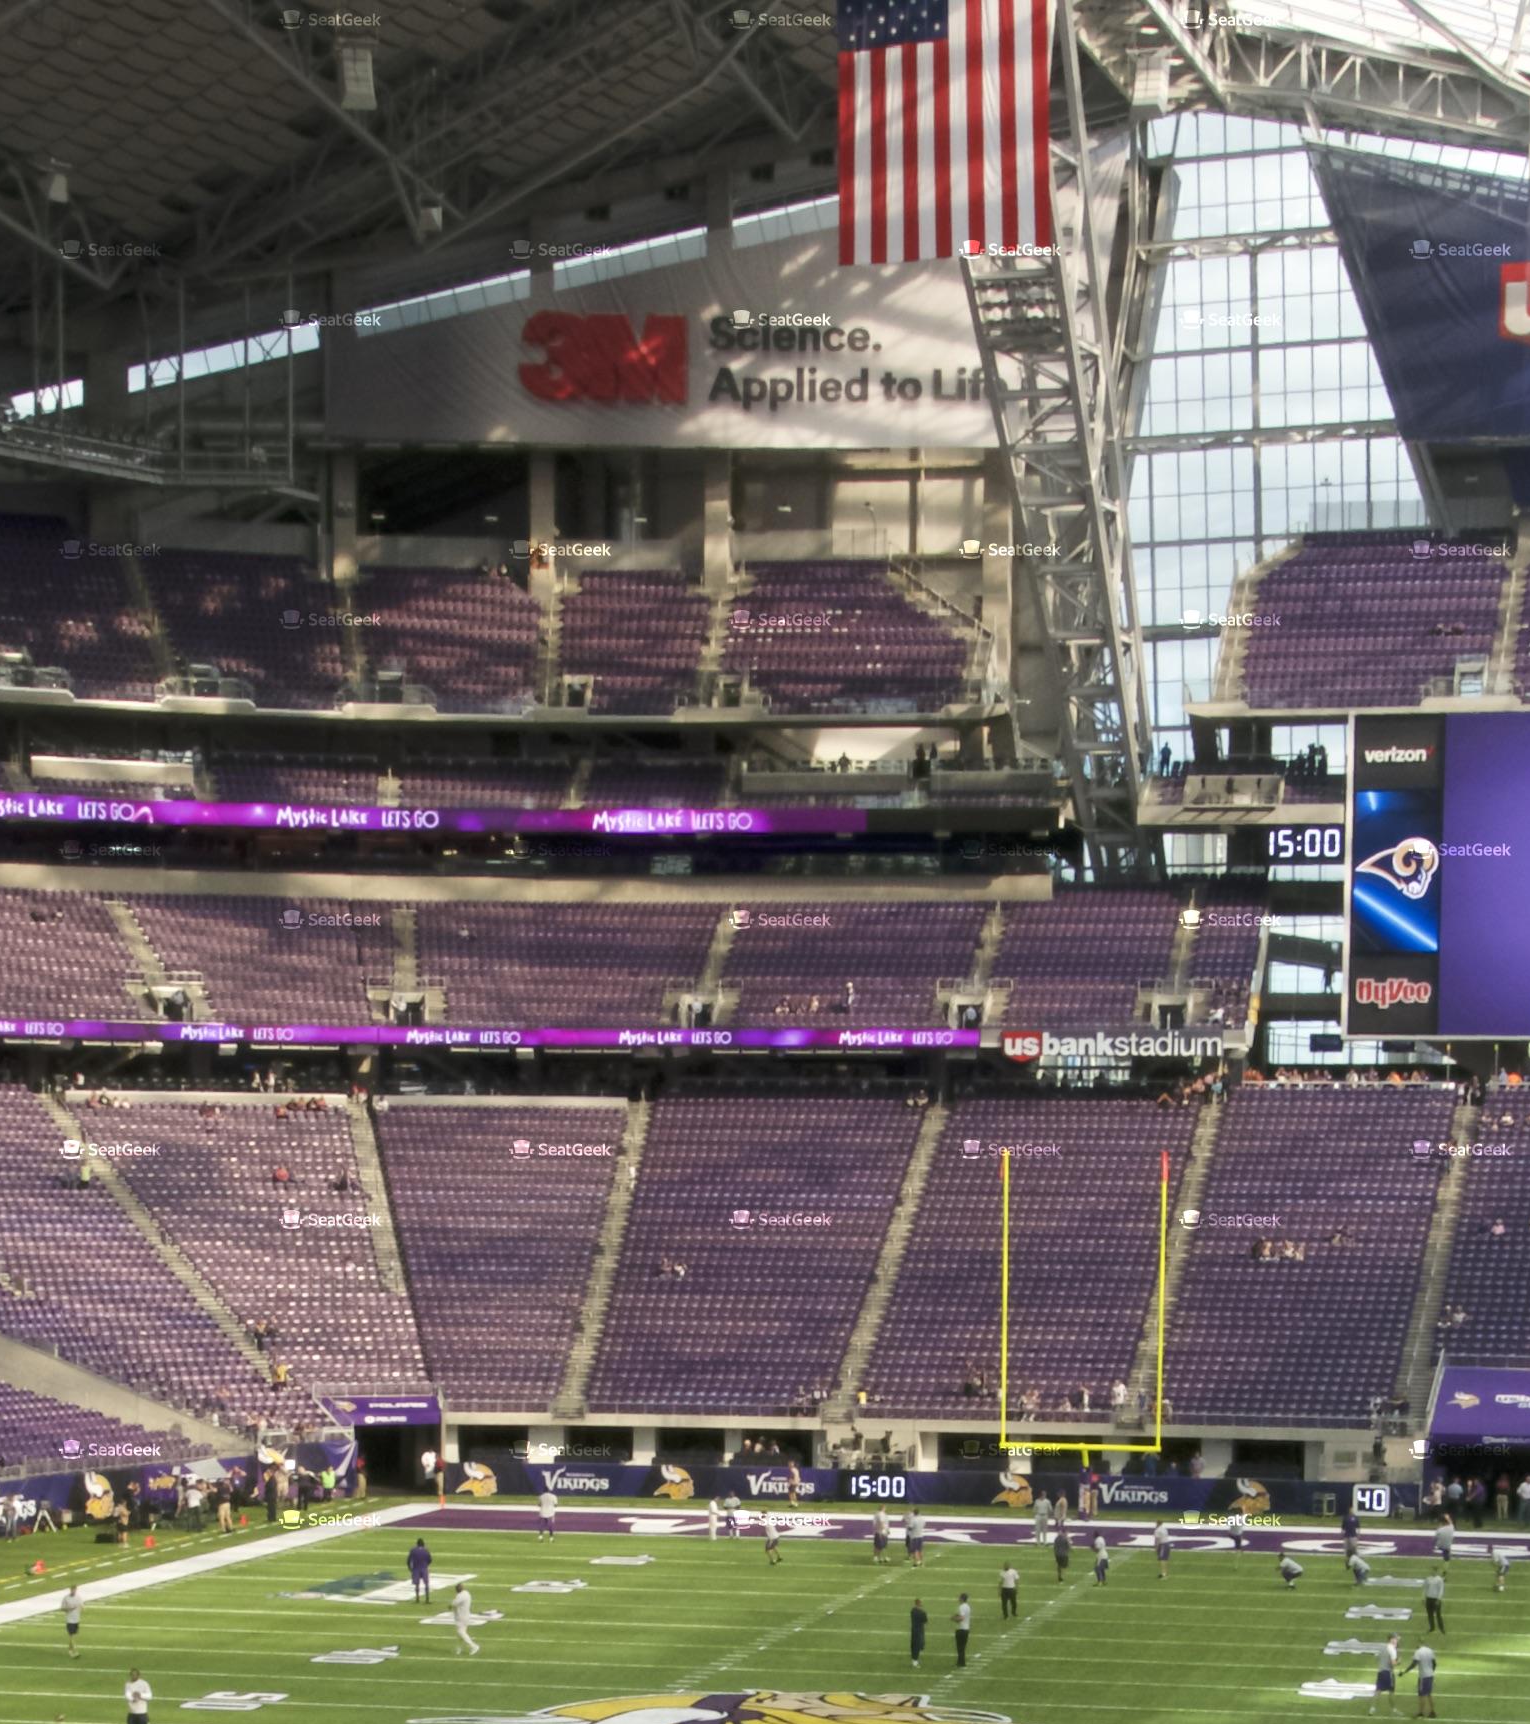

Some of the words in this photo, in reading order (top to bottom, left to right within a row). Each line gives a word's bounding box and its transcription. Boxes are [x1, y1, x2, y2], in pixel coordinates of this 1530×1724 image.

[708, 315, 882, 354] Science.
[518, 309, 689, 405] 3M
[708, 366, 868, 410] Applied
[880, 370, 922, 401] to
[1364, 745, 1428, 763] verizon
[1268, 828, 1341, 858] 15:00
[851, 1474, 906, 1499] 15:00
[1355, 1489, 1386, 1512] 40
